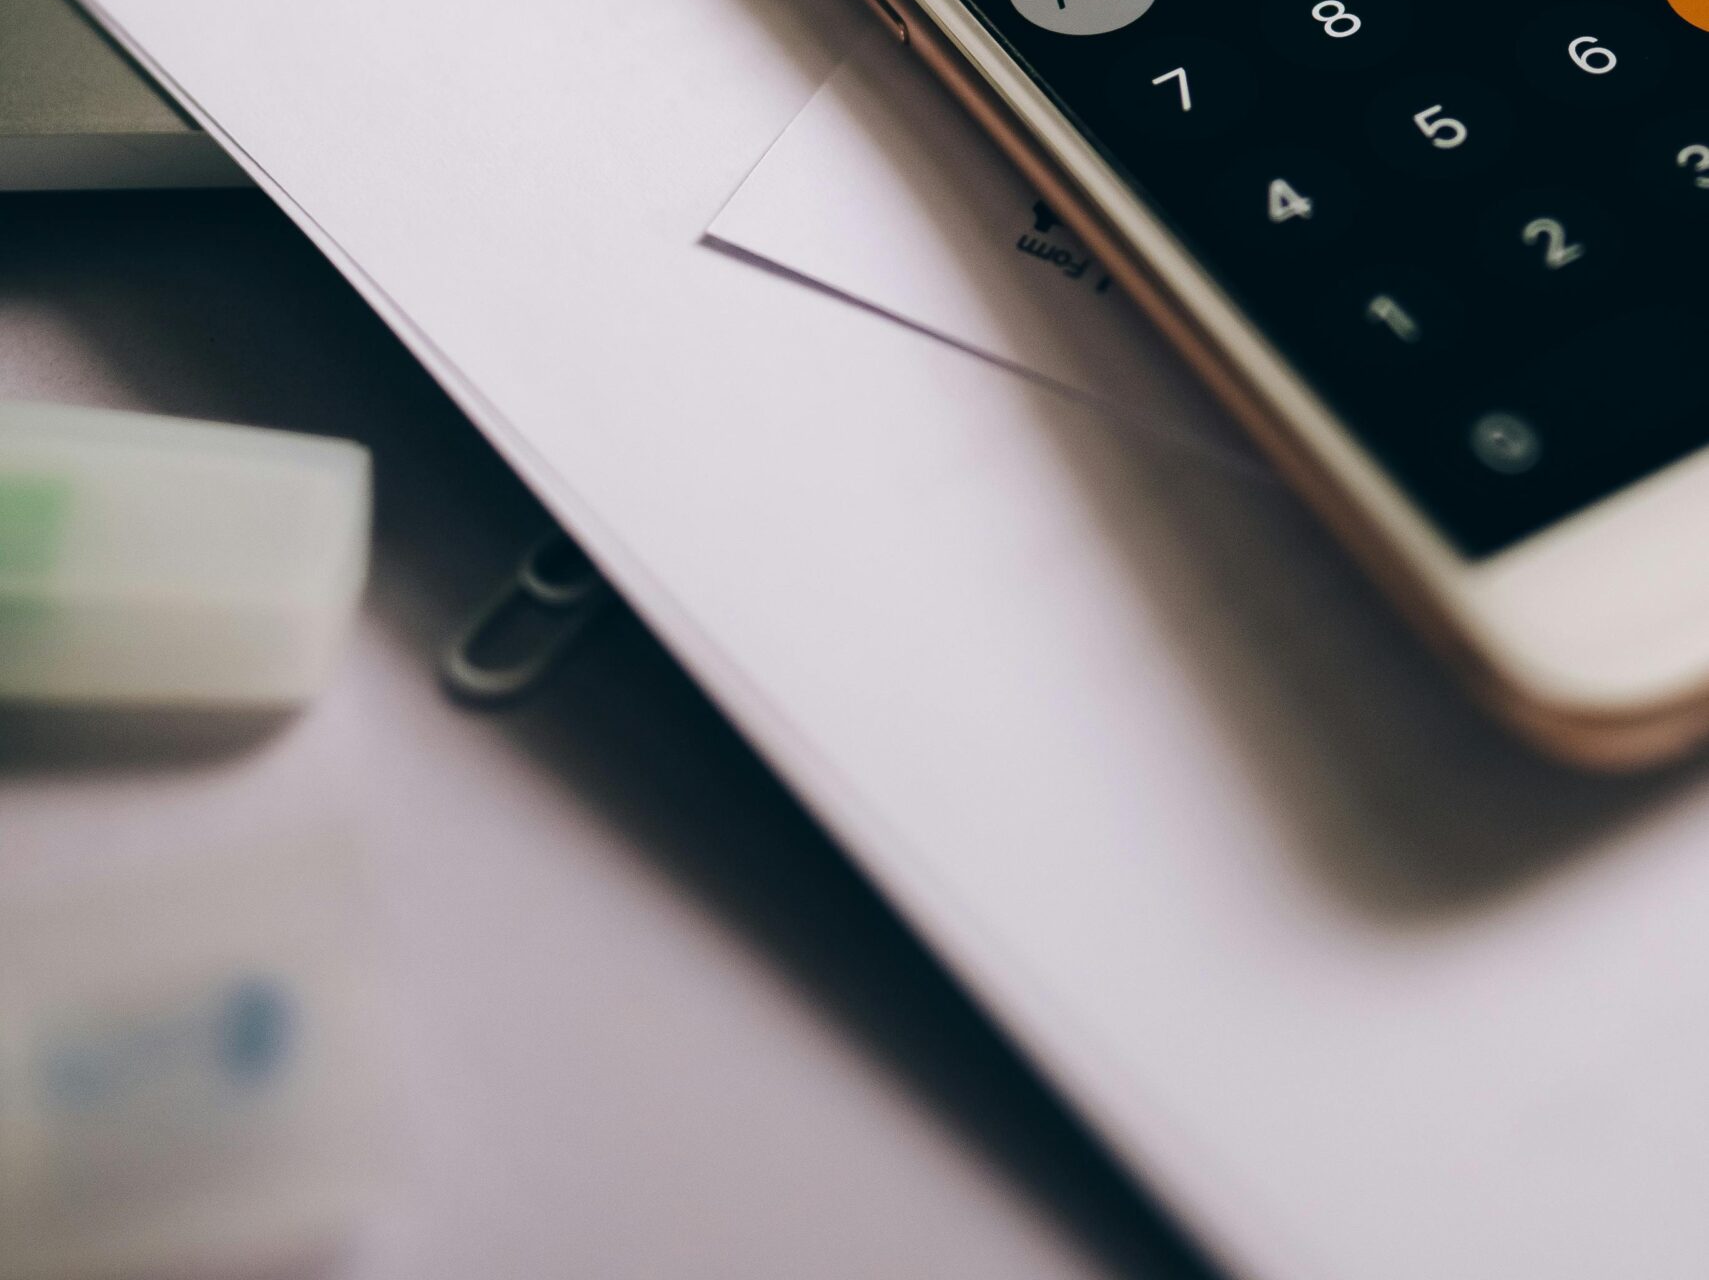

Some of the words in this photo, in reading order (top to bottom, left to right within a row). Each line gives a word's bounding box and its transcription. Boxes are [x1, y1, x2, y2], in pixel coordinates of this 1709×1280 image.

[1151, 66, 1192, 111] 7
[1311, 0, 1362, 38] 8
[1268, 178, 1312, 222] 4
[1413, 104, 1468, 149] 5
[1567, 35, 1618, 75] 6
[1016, 234, 1091, 279] Form
[1522, 217, 1581, 269] 2
